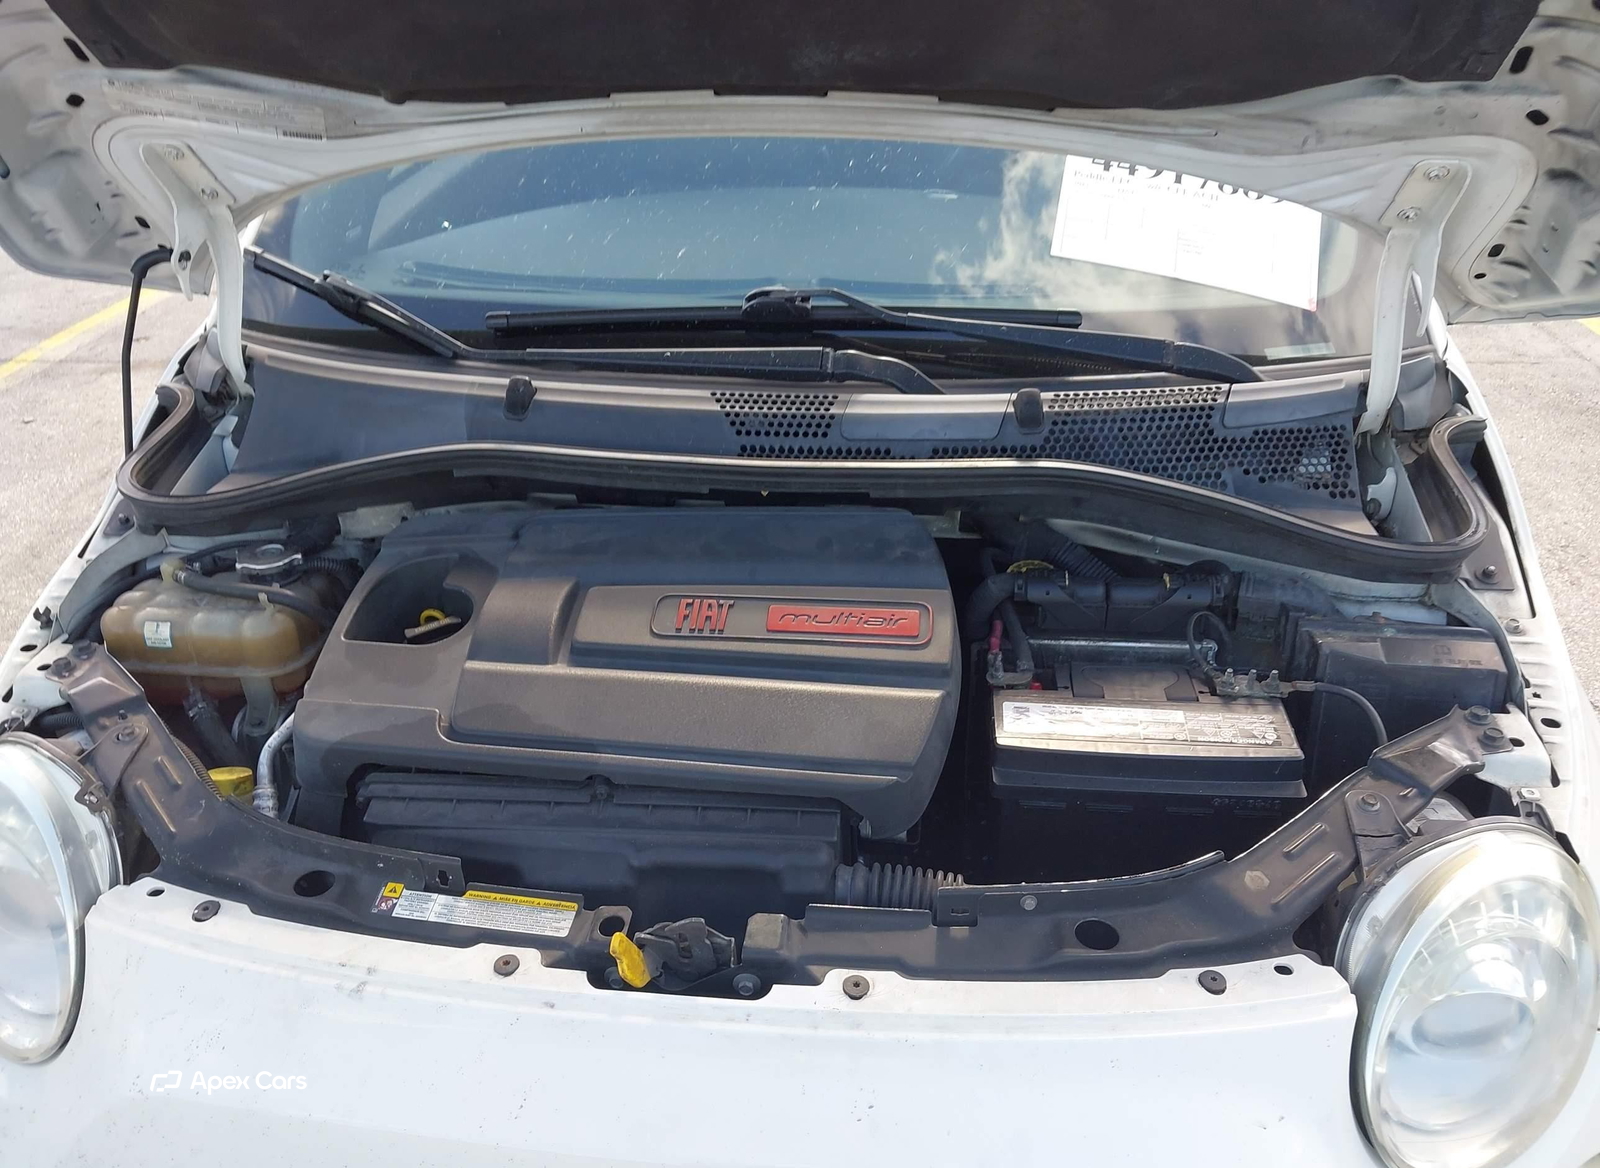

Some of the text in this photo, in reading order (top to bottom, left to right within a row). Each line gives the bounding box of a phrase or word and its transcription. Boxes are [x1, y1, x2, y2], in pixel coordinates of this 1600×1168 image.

[675, 598, 909, 634] FIAT multiair
[468, 892, 492, 900] WARNING
